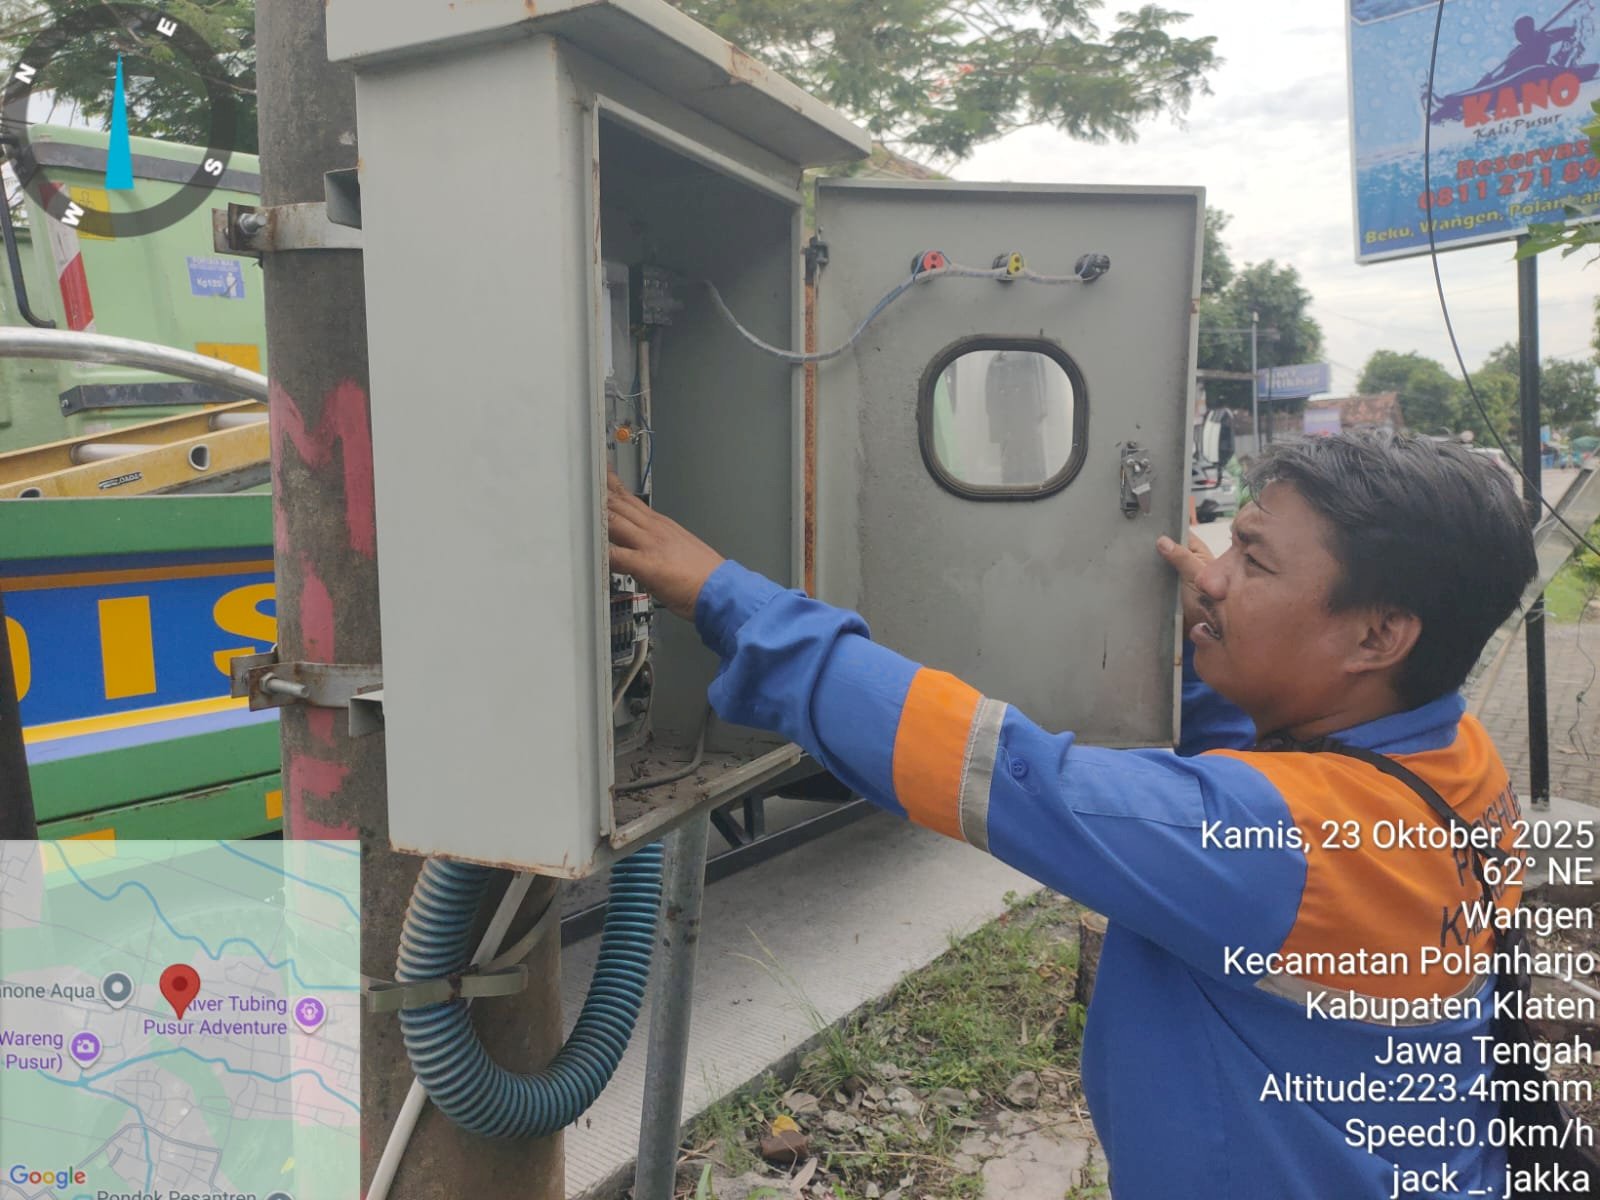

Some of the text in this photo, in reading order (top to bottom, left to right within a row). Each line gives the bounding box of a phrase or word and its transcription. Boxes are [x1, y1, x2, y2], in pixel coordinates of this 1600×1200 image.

[1462, 72, 1581, 128] KANO
[1418, 180, 1488, 210] 0811
[1498, 167, 1552, 196] 271
[1364, 226, 1415, 244] Beku,
[1419, 209, 1504, 233] Wangen,
